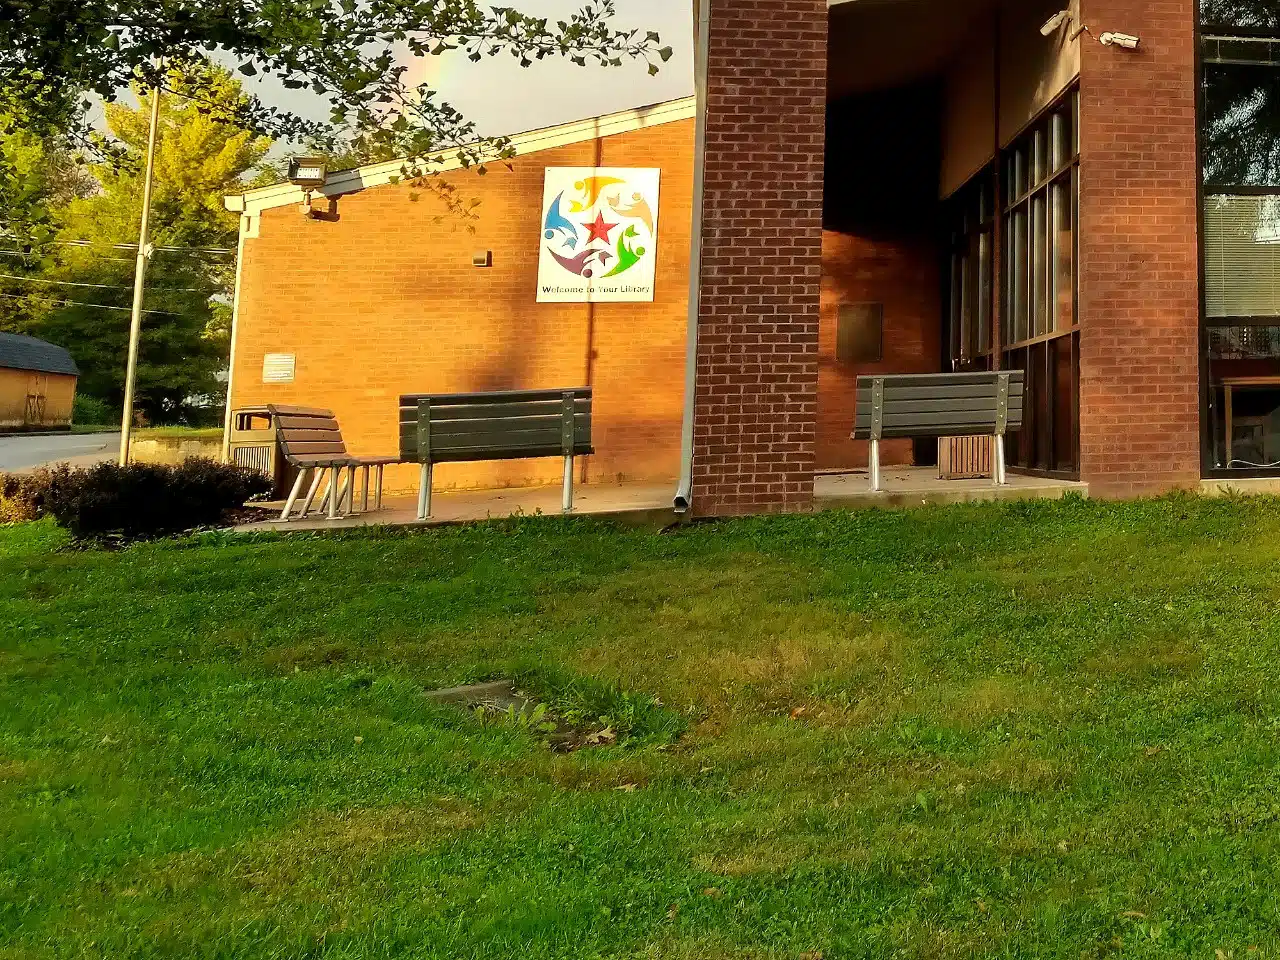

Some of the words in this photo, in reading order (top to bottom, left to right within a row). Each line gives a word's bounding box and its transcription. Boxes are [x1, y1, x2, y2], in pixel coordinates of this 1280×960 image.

[542, 285, 584, 294] Welcome
[586, 285, 595, 294] to
[598, 285, 619, 294] Your
[620, 285, 650, 294] Library
